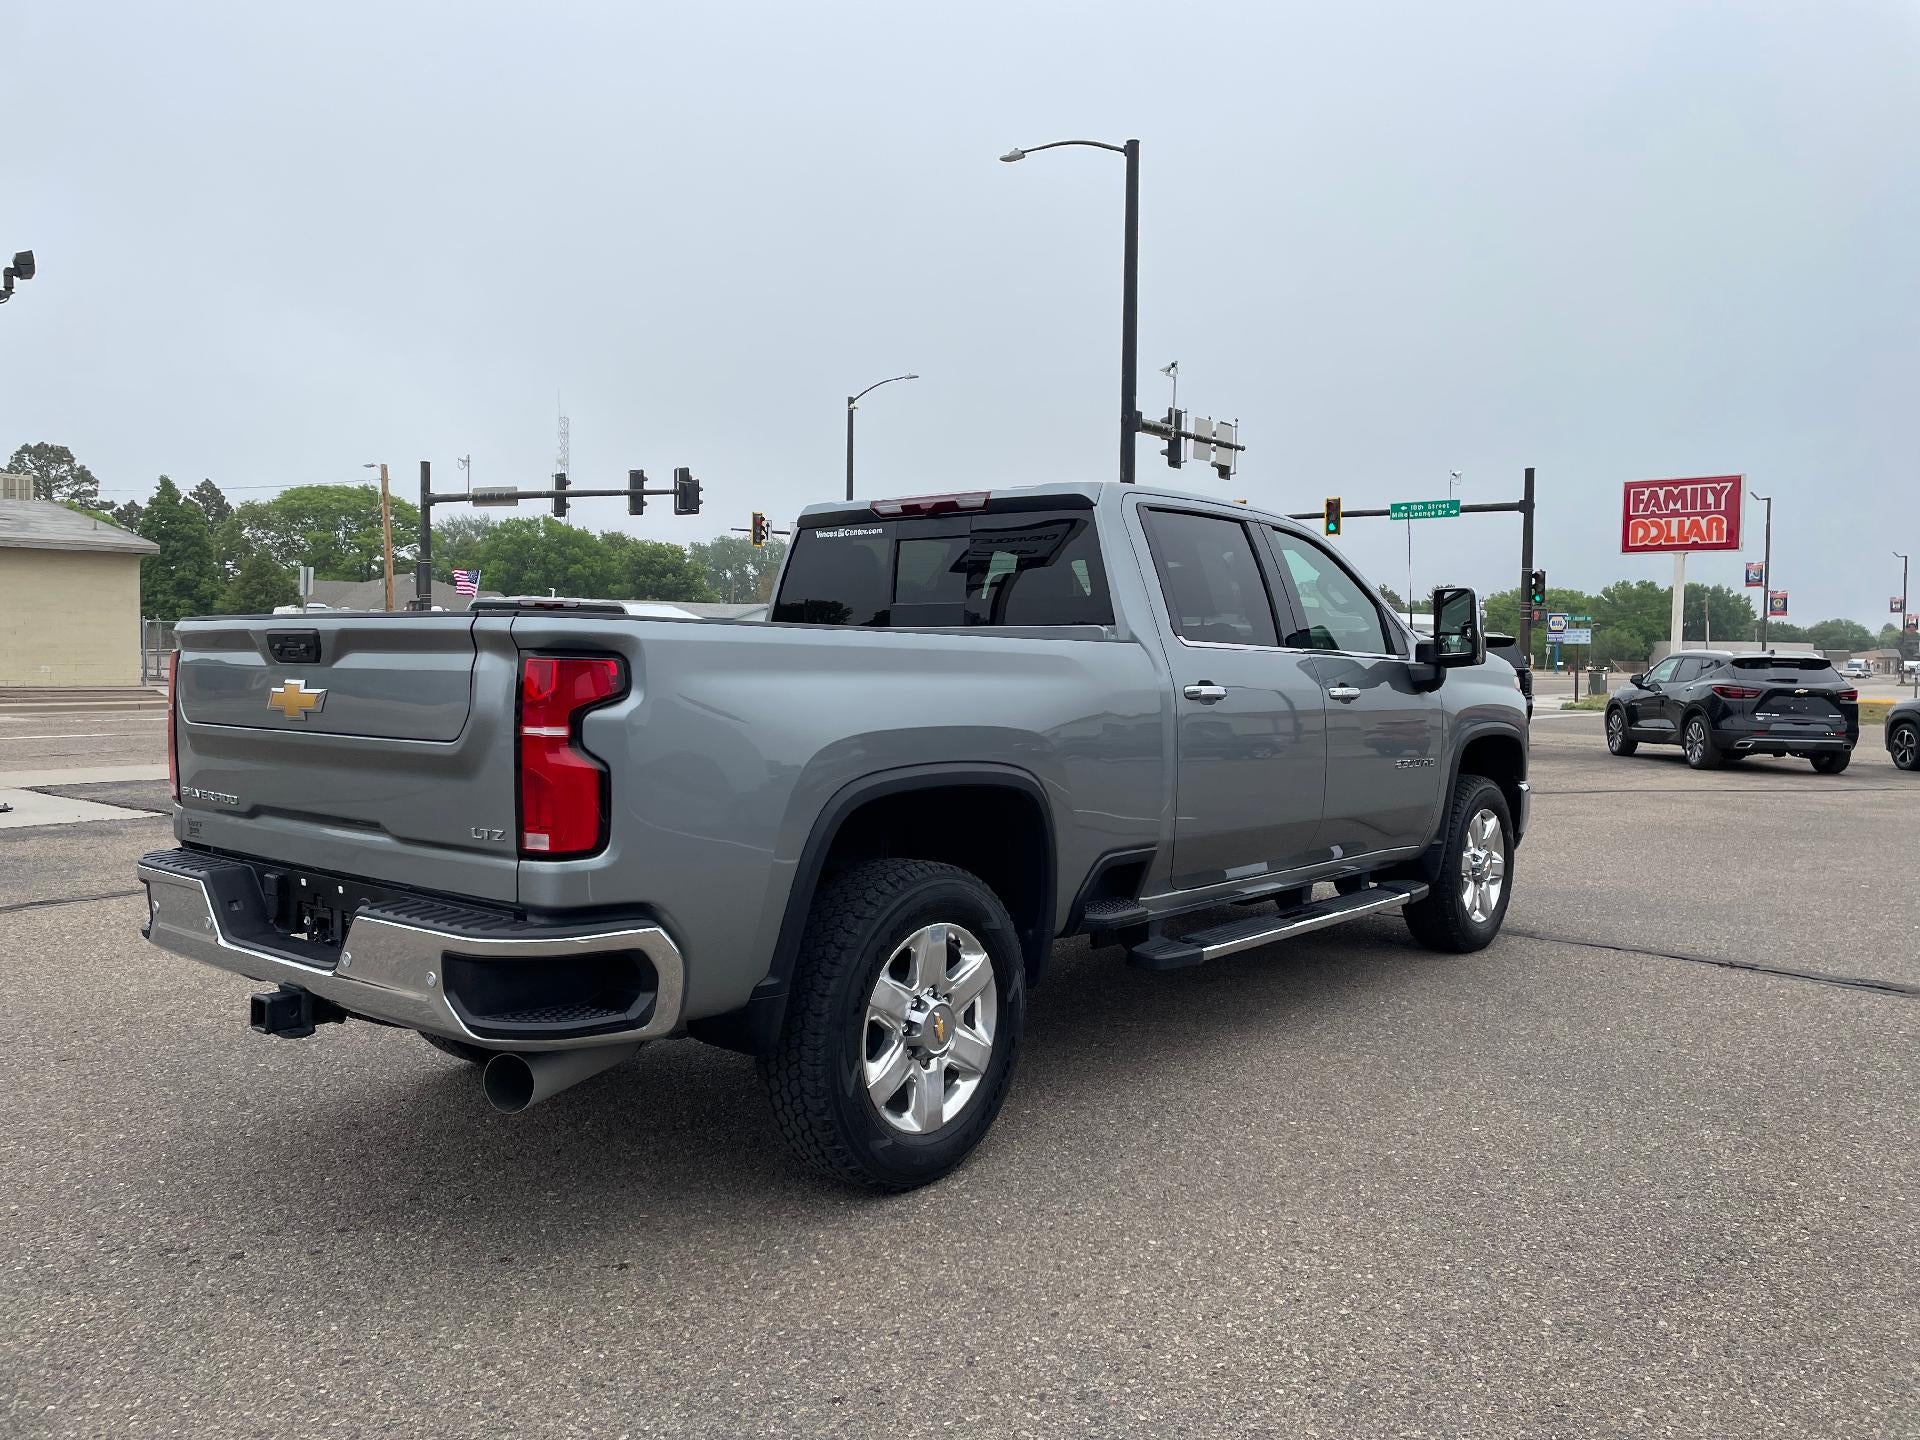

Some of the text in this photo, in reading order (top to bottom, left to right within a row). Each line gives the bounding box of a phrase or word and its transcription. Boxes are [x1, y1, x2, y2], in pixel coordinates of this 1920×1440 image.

[1427, 502, 1450, 510] Street
[1630, 483, 1733, 515] FAMILY
[1409, 510, 1436, 518] Lounge
[1629, 515, 1727, 546] DOLLAR
[182, 786, 239, 805] SILVERADO
[471, 827, 506, 841] LTZ
